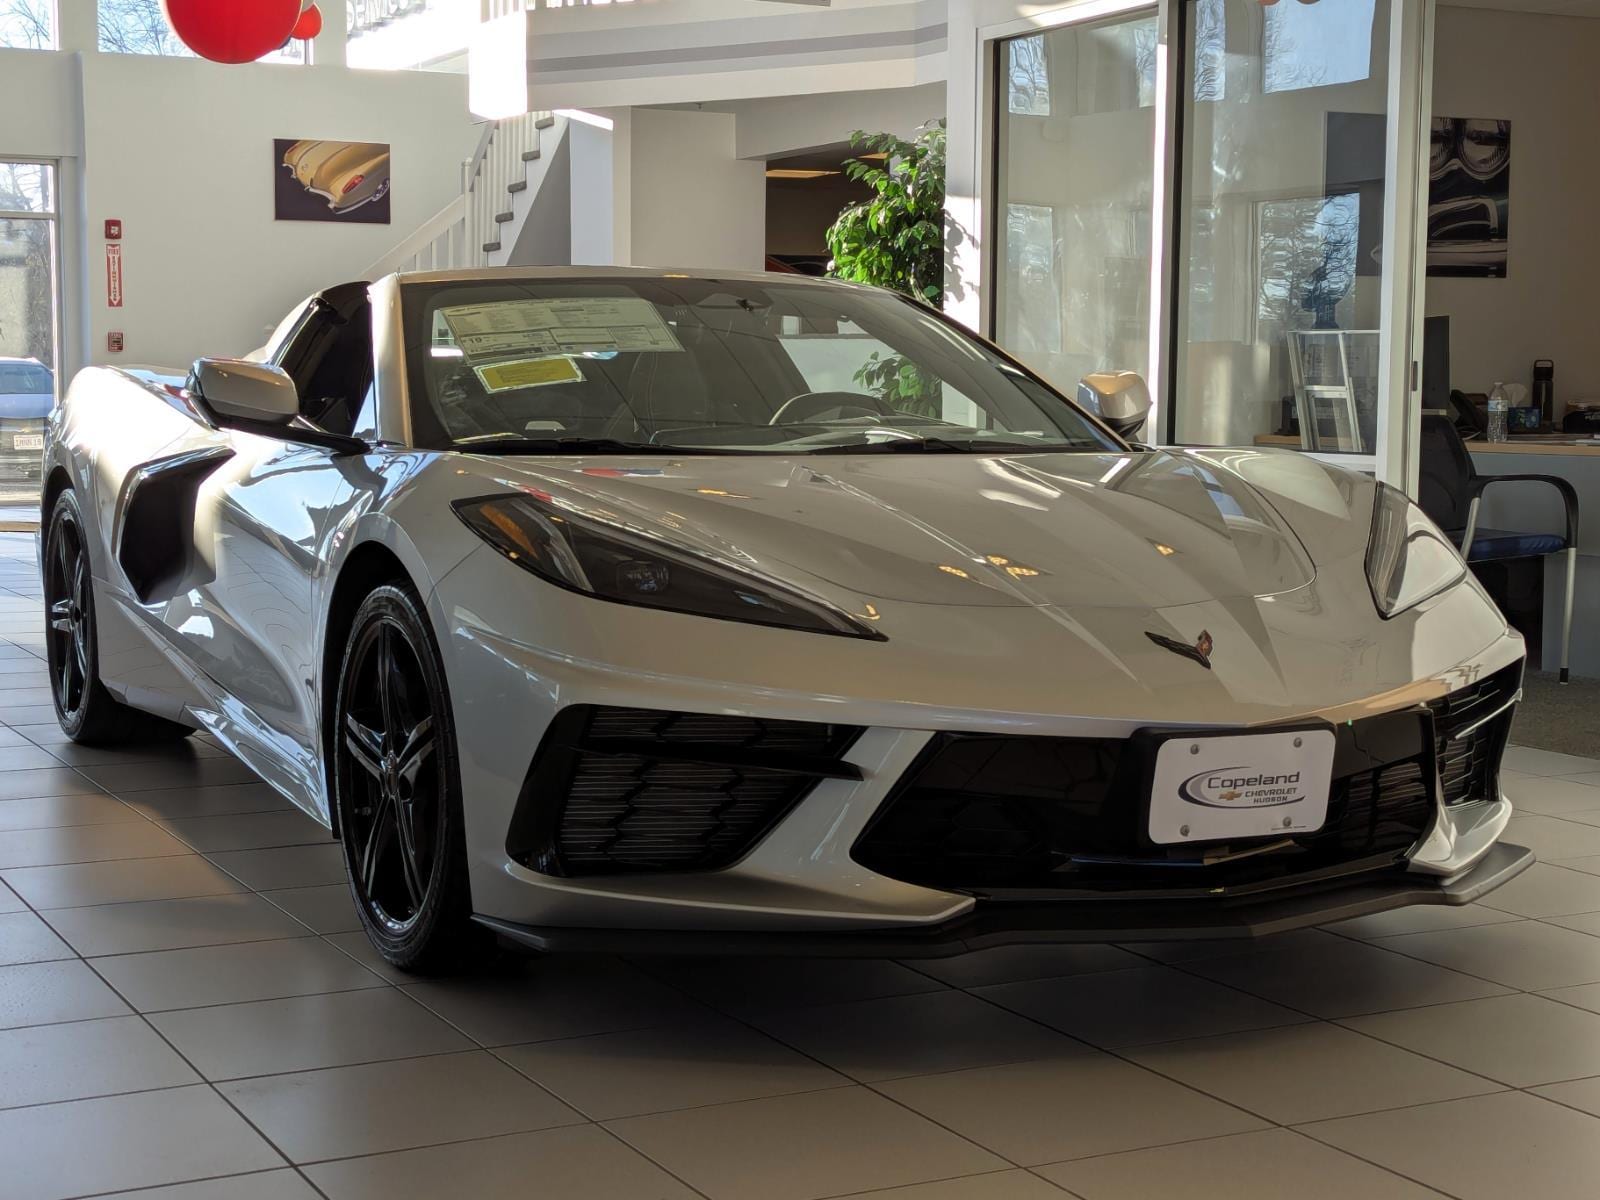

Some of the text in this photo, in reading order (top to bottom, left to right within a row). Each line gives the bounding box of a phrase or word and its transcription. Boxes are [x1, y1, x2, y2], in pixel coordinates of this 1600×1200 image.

[1208, 772, 1300, 790] Copeland
[1244, 787, 1297, 798] CHEVROLET
[1253, 796, 1288, 804] HUDSON
